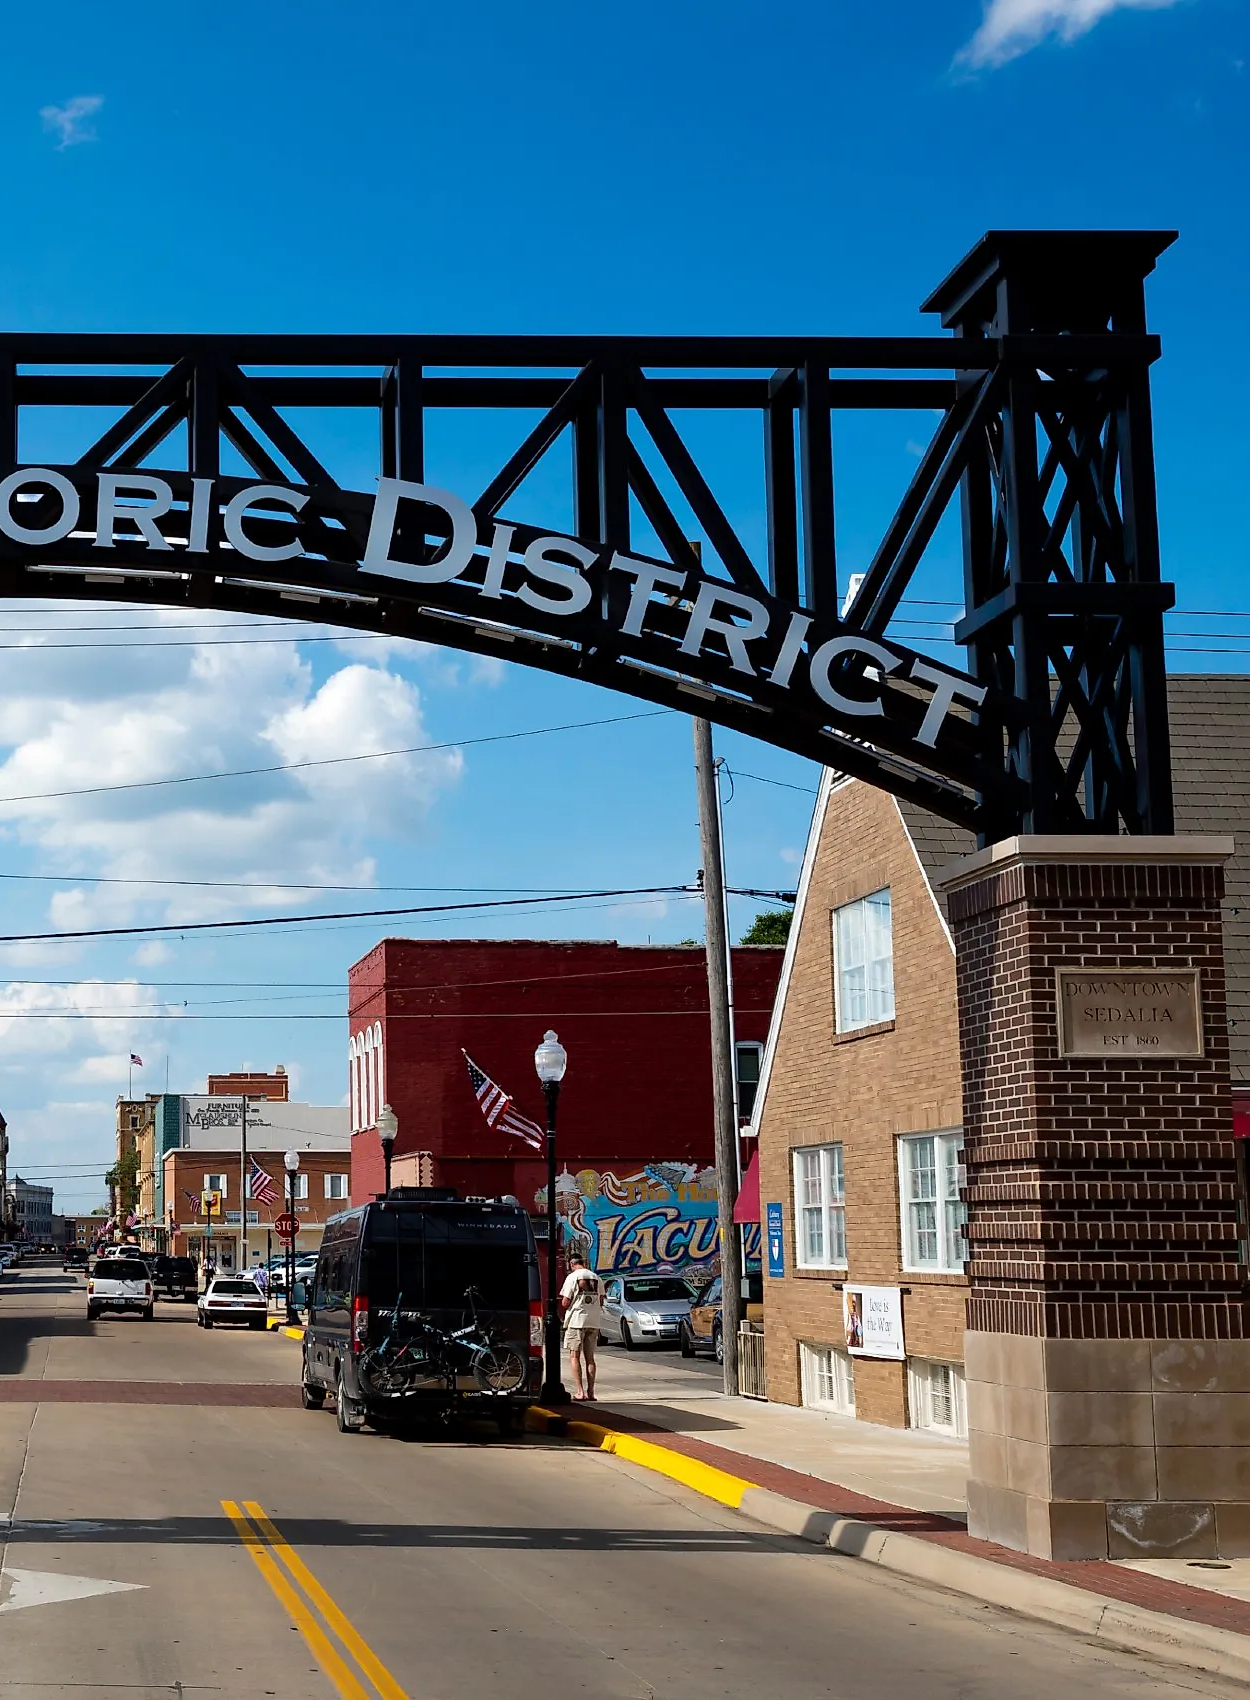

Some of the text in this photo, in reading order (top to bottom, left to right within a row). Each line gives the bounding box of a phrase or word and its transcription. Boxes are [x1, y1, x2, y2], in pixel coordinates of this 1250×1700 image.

[355, 475, 989, 750] DISTRICT
[1065, 982, 1191, 998] DOWNTOWN
[1084, 1007, 1173, 1022] SEDALIA
[1136, 1035, 1160, 1045] 1860
[622, 1181, 670, 1201] The
[275, 1220, 299, 1231] STOP
